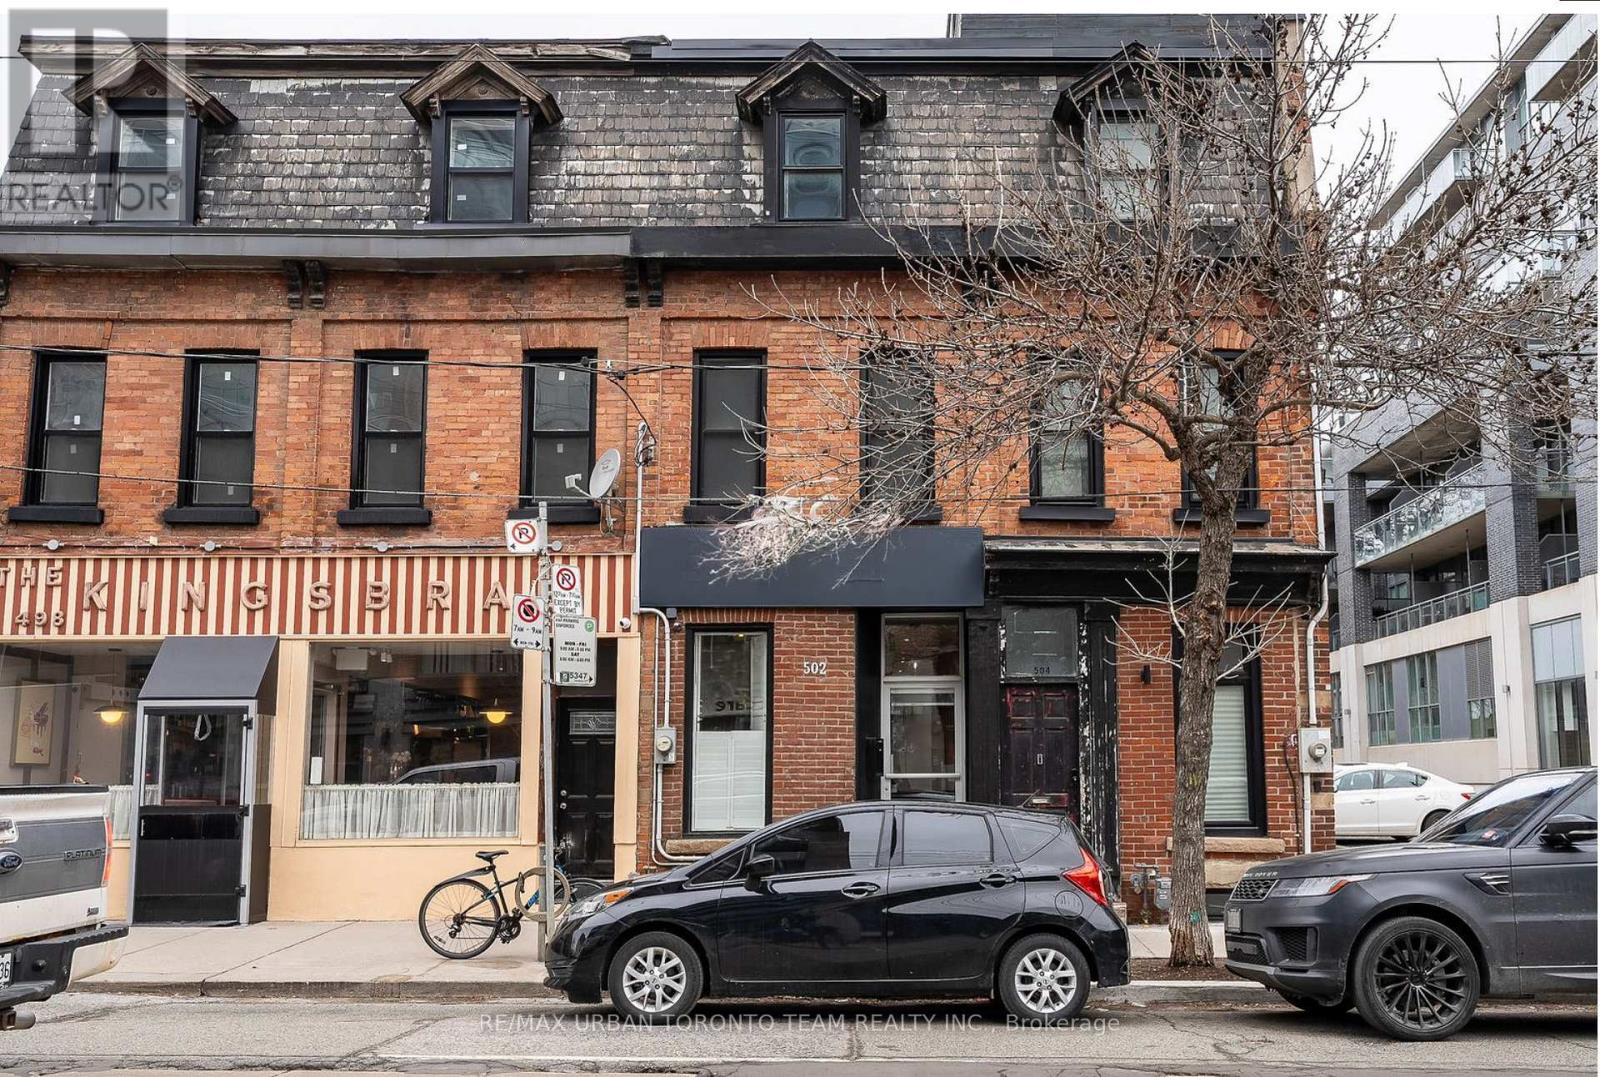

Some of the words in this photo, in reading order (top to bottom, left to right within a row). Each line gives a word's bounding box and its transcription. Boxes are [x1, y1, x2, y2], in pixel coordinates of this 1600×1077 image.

[0, 566, 62, 587] THE
[83, 580, 510, 612] KINGSBRA
[15, 611, 65, 627] 498
[569, 671, 588, 680] 5347
[803, 661, 827, 675] 502
[1033, 666, 1050, 675] 504
